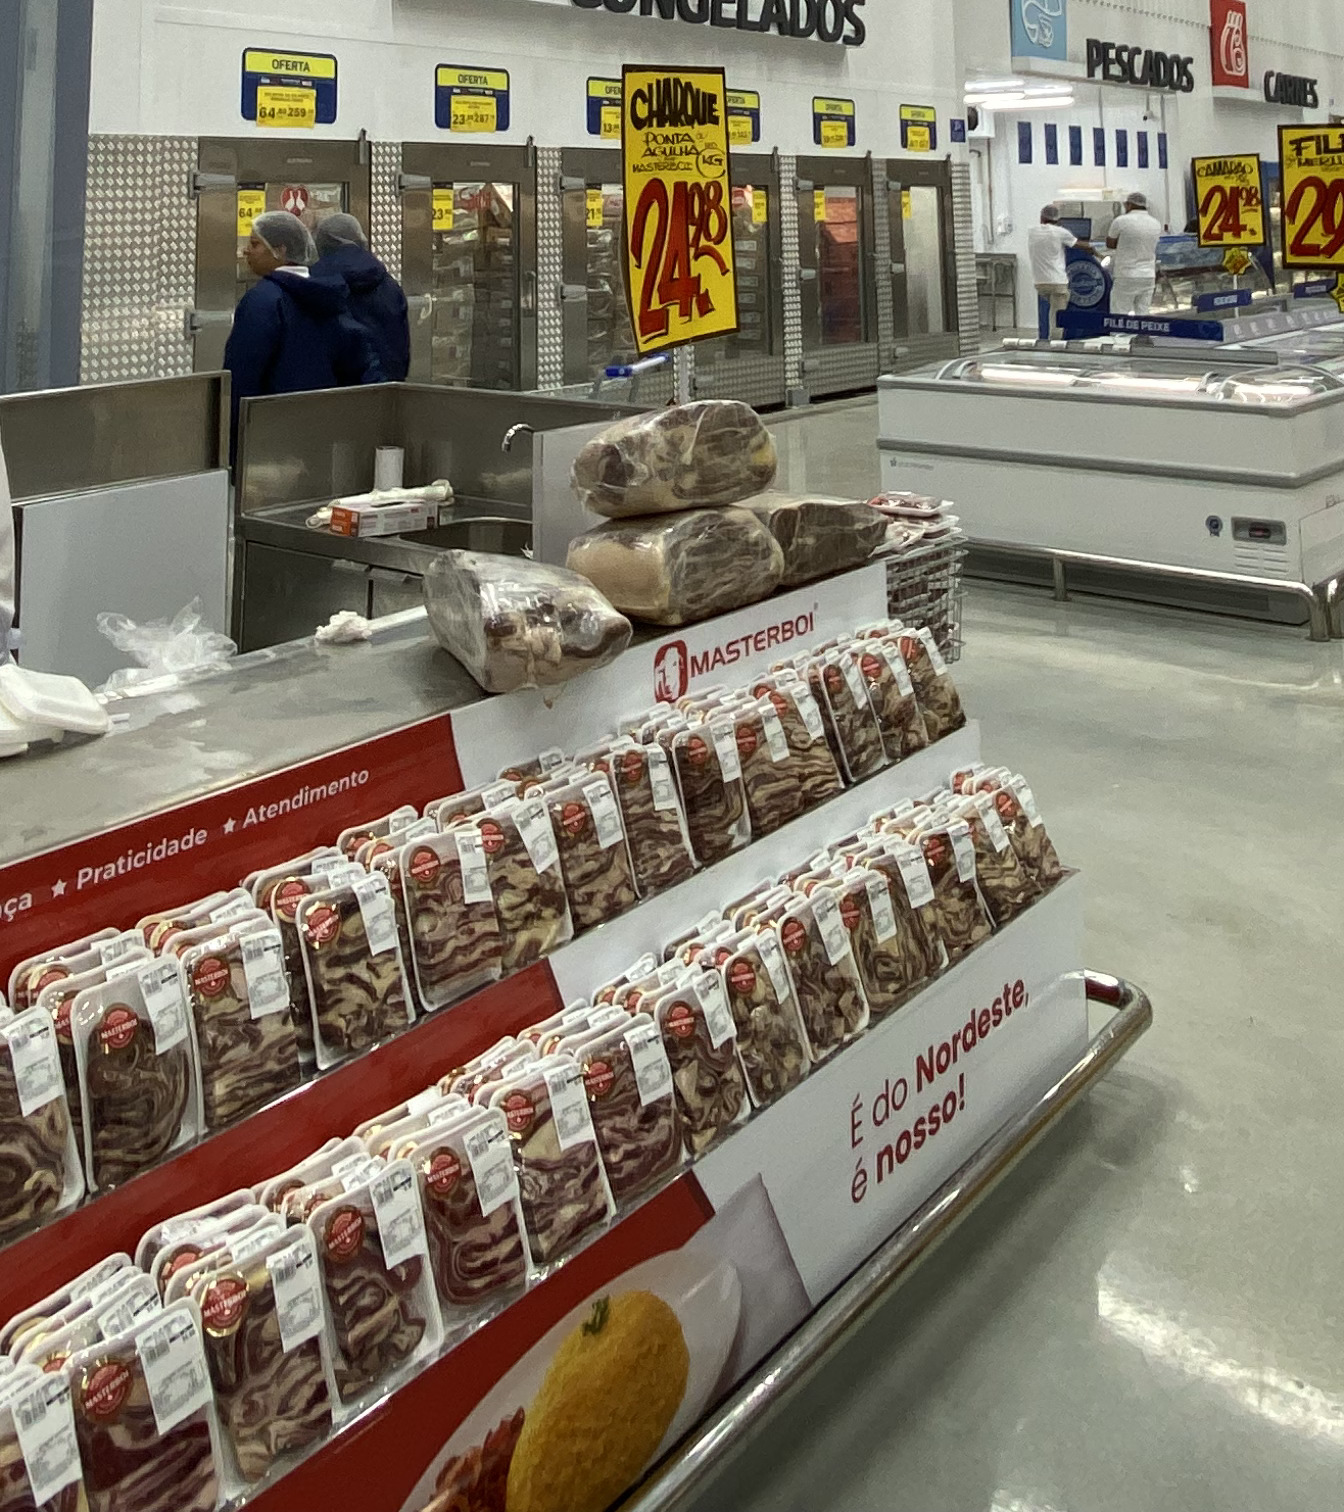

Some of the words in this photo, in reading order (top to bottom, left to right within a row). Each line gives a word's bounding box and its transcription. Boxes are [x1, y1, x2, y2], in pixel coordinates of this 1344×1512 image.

[272, 58, 311, 72] OFERTA
[458, 74, 489, 86] OFERTA
[1086, 38, 1194, 93] PESCADOS
[630, 78, 720, 131] CHARQUE
[642, 146, 700, 158] AGULHA
[643, 132, 695, 147] PONTA
[1126, 320, 1140, 330] DE
[1141, 320, 1171, 332] PEIXE
[690, 610, 816, 679] MASTERBOI
[76, 827, 208, 890] Praticidade
[242, 767, 370, 829] Atendimento
[850, 1093, 864, 1149] É
[872, 1077, 909, 1127] do
[915, 978, 1030, 1093] Nordeste,
[850, 1156, 868, 1204] é
[876, 1072, 966, 1184] nosso!
